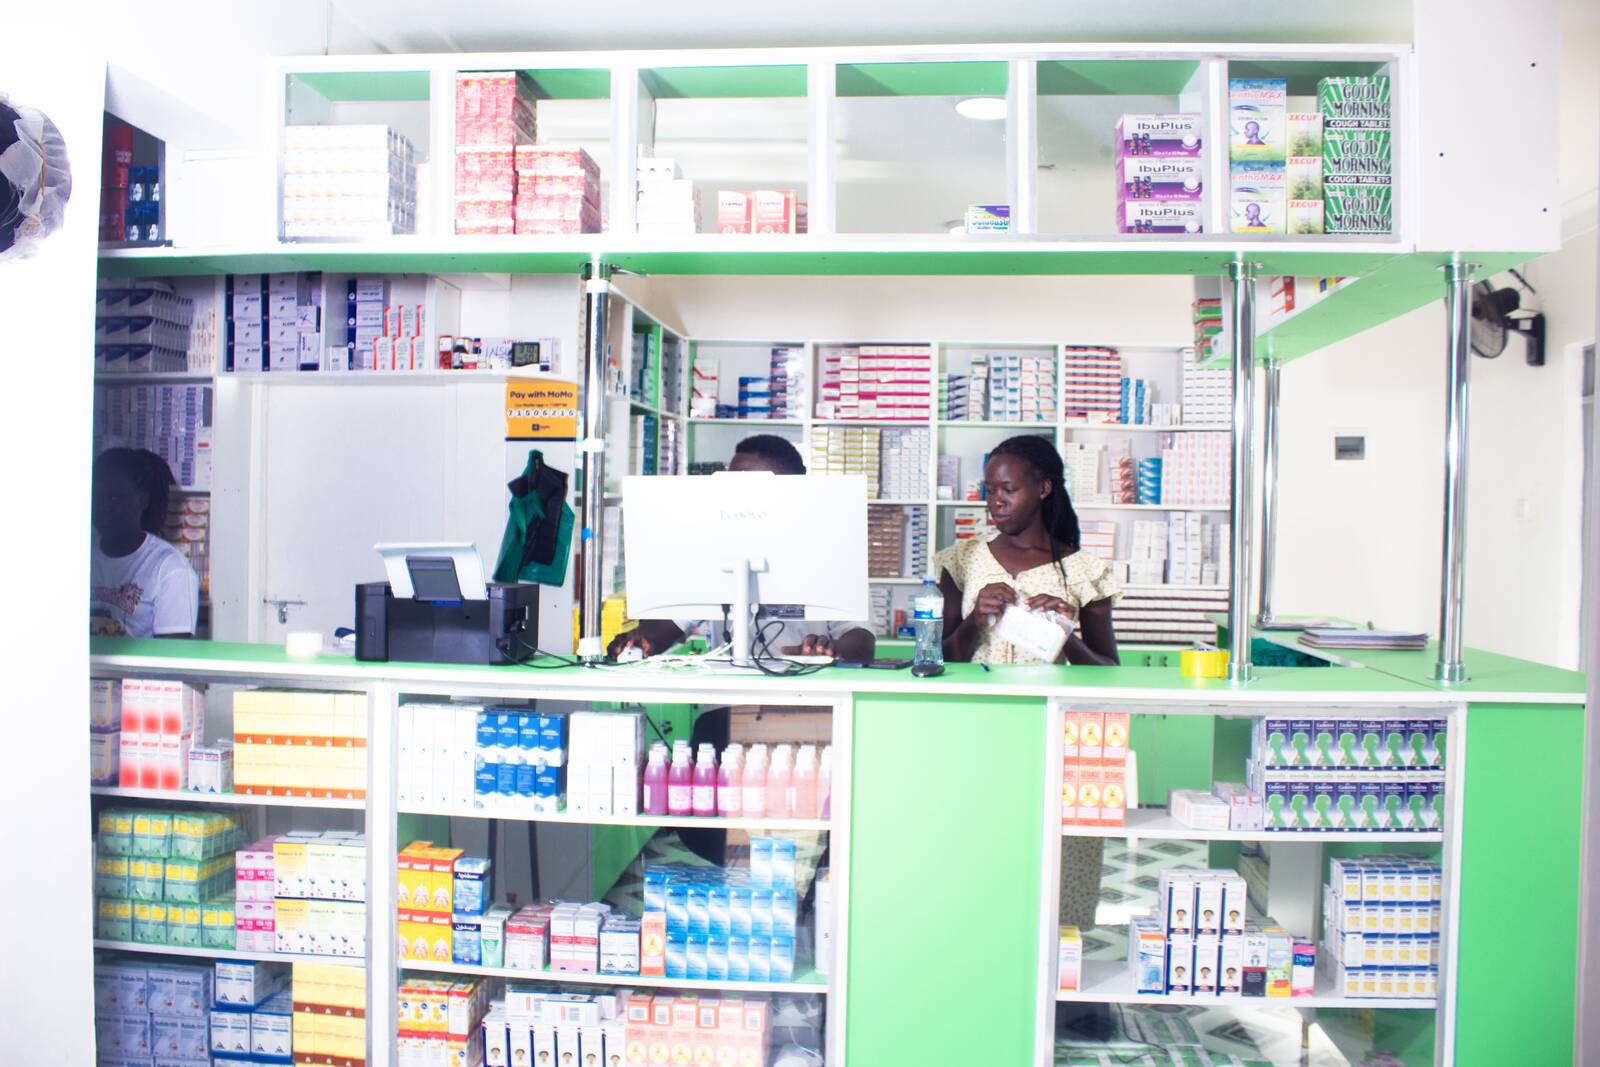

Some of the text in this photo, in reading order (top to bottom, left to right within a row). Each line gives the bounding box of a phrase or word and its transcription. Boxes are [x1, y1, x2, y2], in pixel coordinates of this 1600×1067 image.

[1343, 84, 1380, 99] GOOD
[1333, 102, 1390, 116] MORNING
[1137, 122, 1192, 130] IbuPlus
[1329, 120, 1359, 128] COUGH
[1341, 140, 1378, 154] GOOD
[1139, 165, 1194, 173] IbuPlus
[1332, 158, 1388, 171] MORNING
[1328, 176, 1390, 184] COUGH TABLETS
[1343, 197, 1380, 211] GOOD
[1140, 208, 1195, 216] IbuPlus
[1333, 214, 1389, 228] MORNING
[510, 391, 525, 399] Pay
